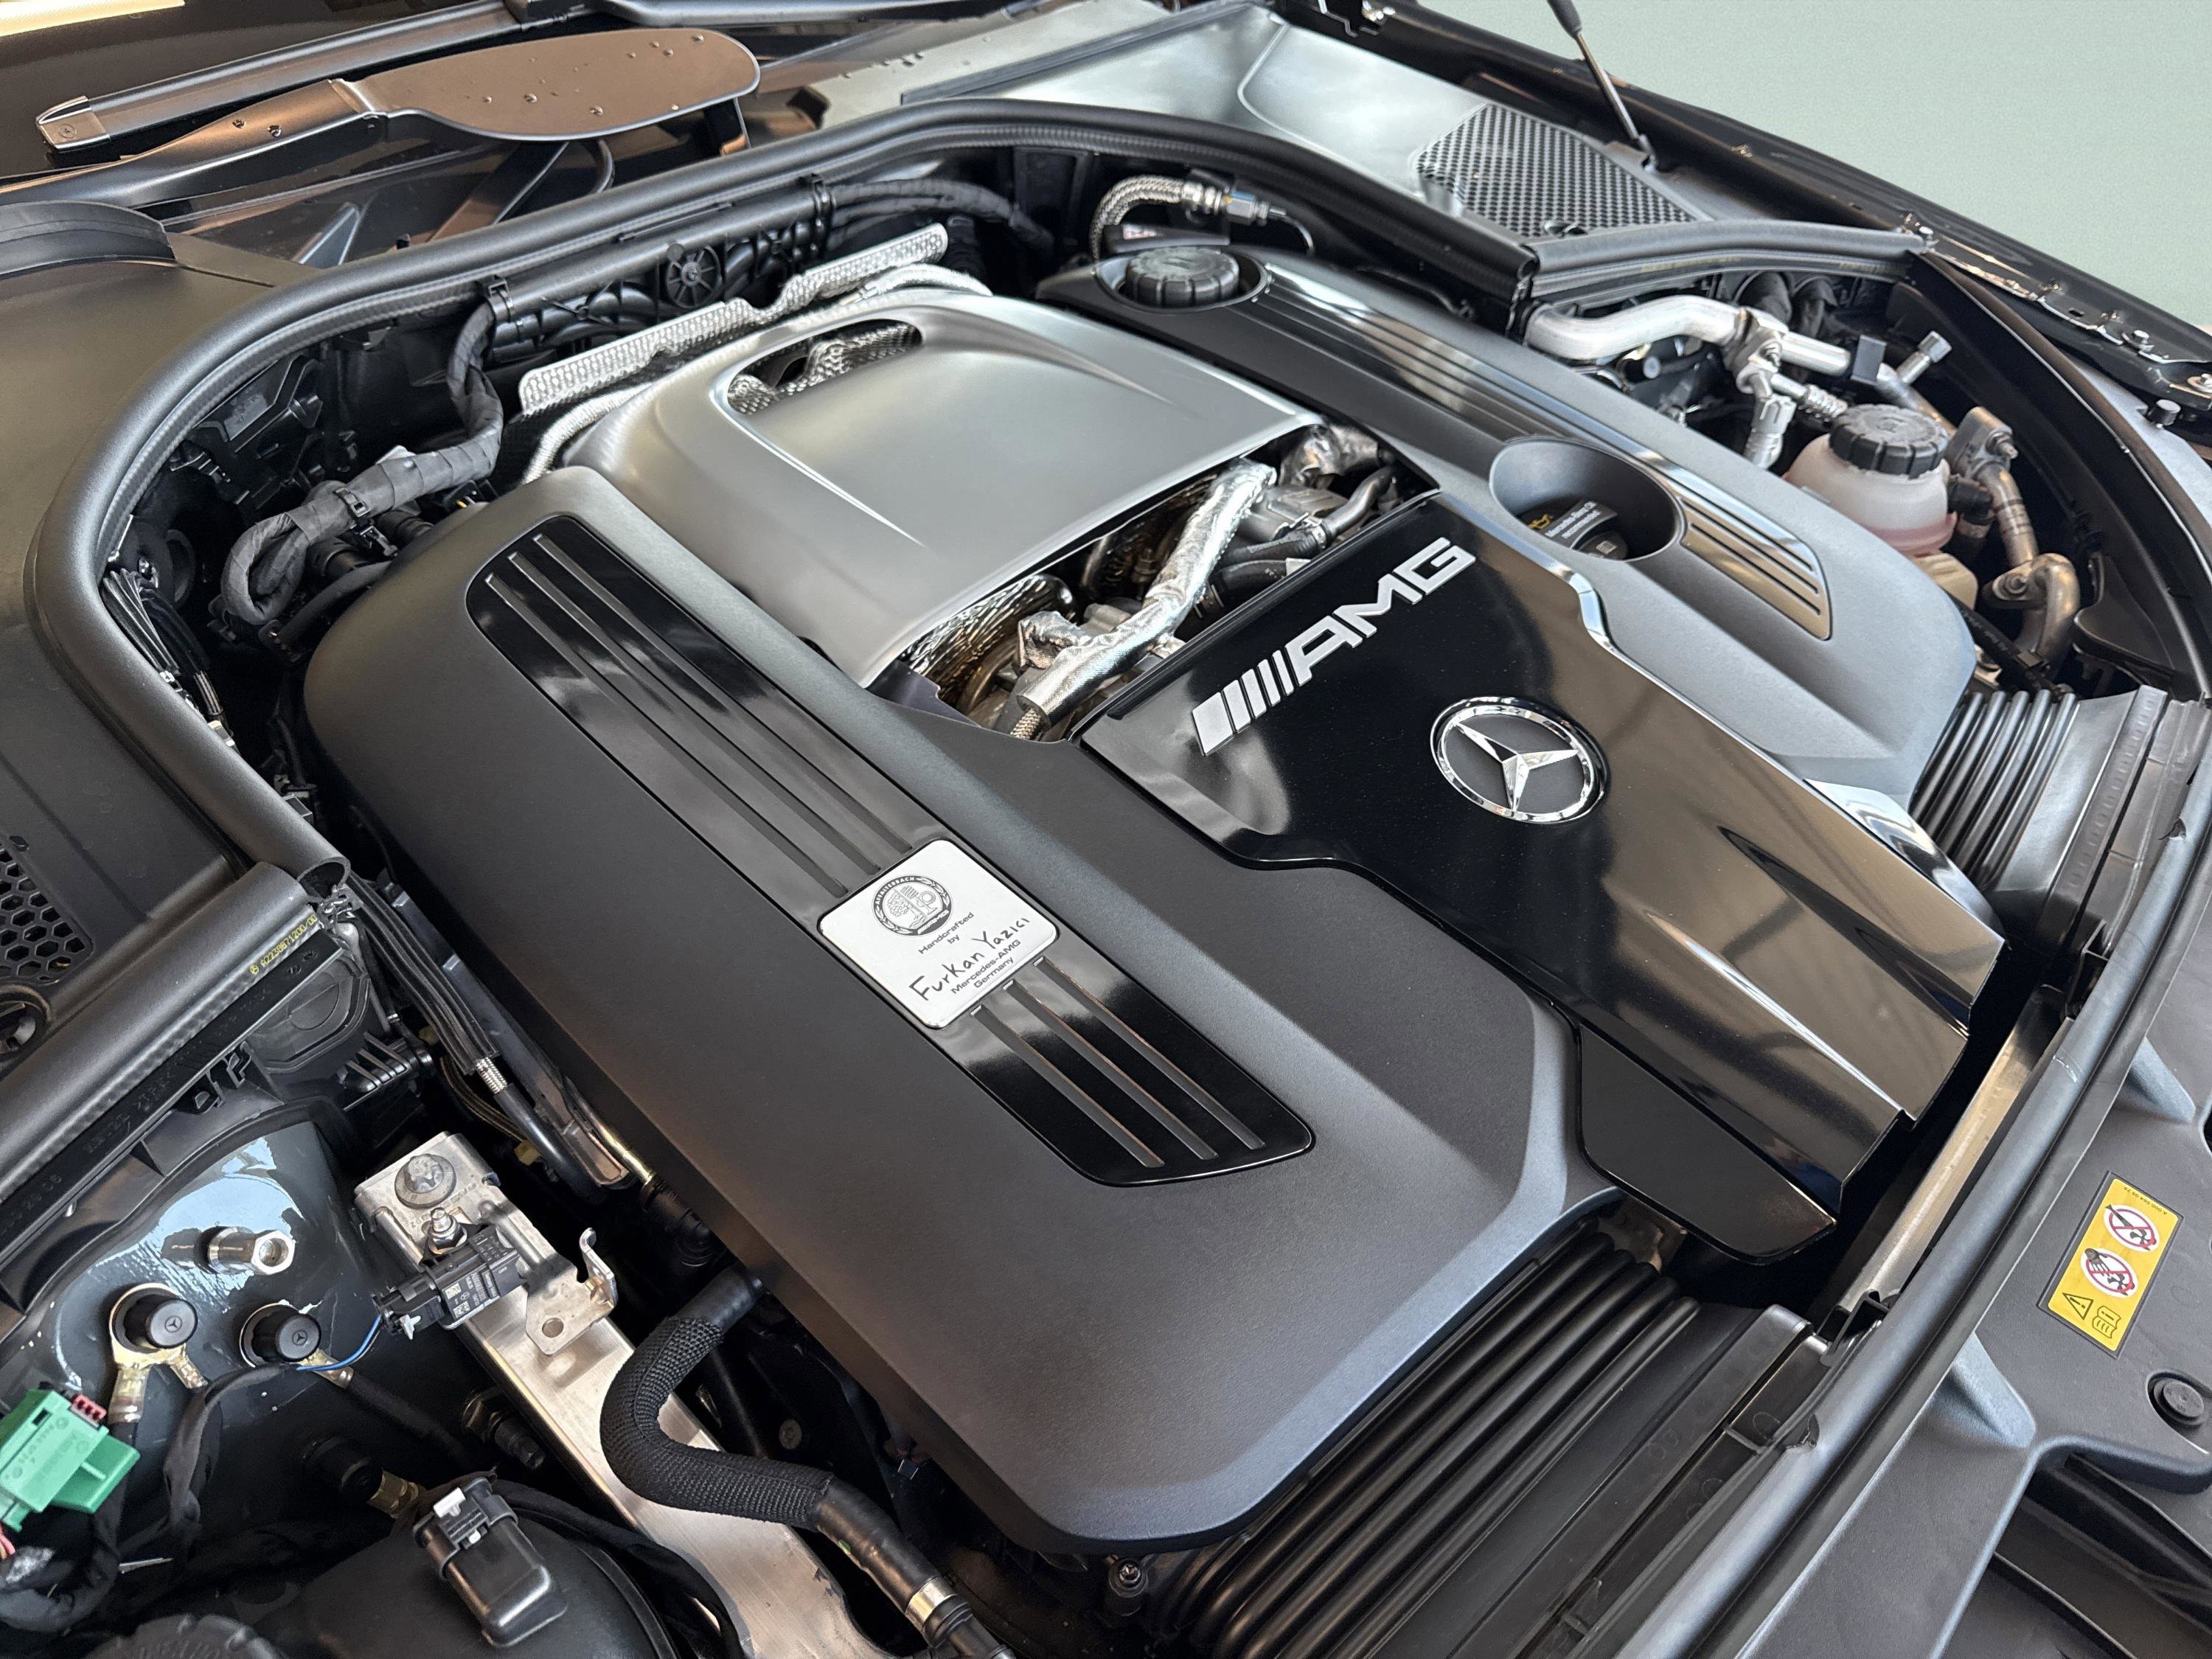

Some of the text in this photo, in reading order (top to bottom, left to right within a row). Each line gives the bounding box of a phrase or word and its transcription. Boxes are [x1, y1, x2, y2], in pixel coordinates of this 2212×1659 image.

[1284, 537, 1475, 686] AMG
[875, 876, 914, 905] AFFALTERBACH
[918, 911, 975, 954] Handcrafted
[947, 934, 960, 945] by
[950, 939, 1021, 994] Mercedes-AMG
[973, 956, 1015, 988] Germany
